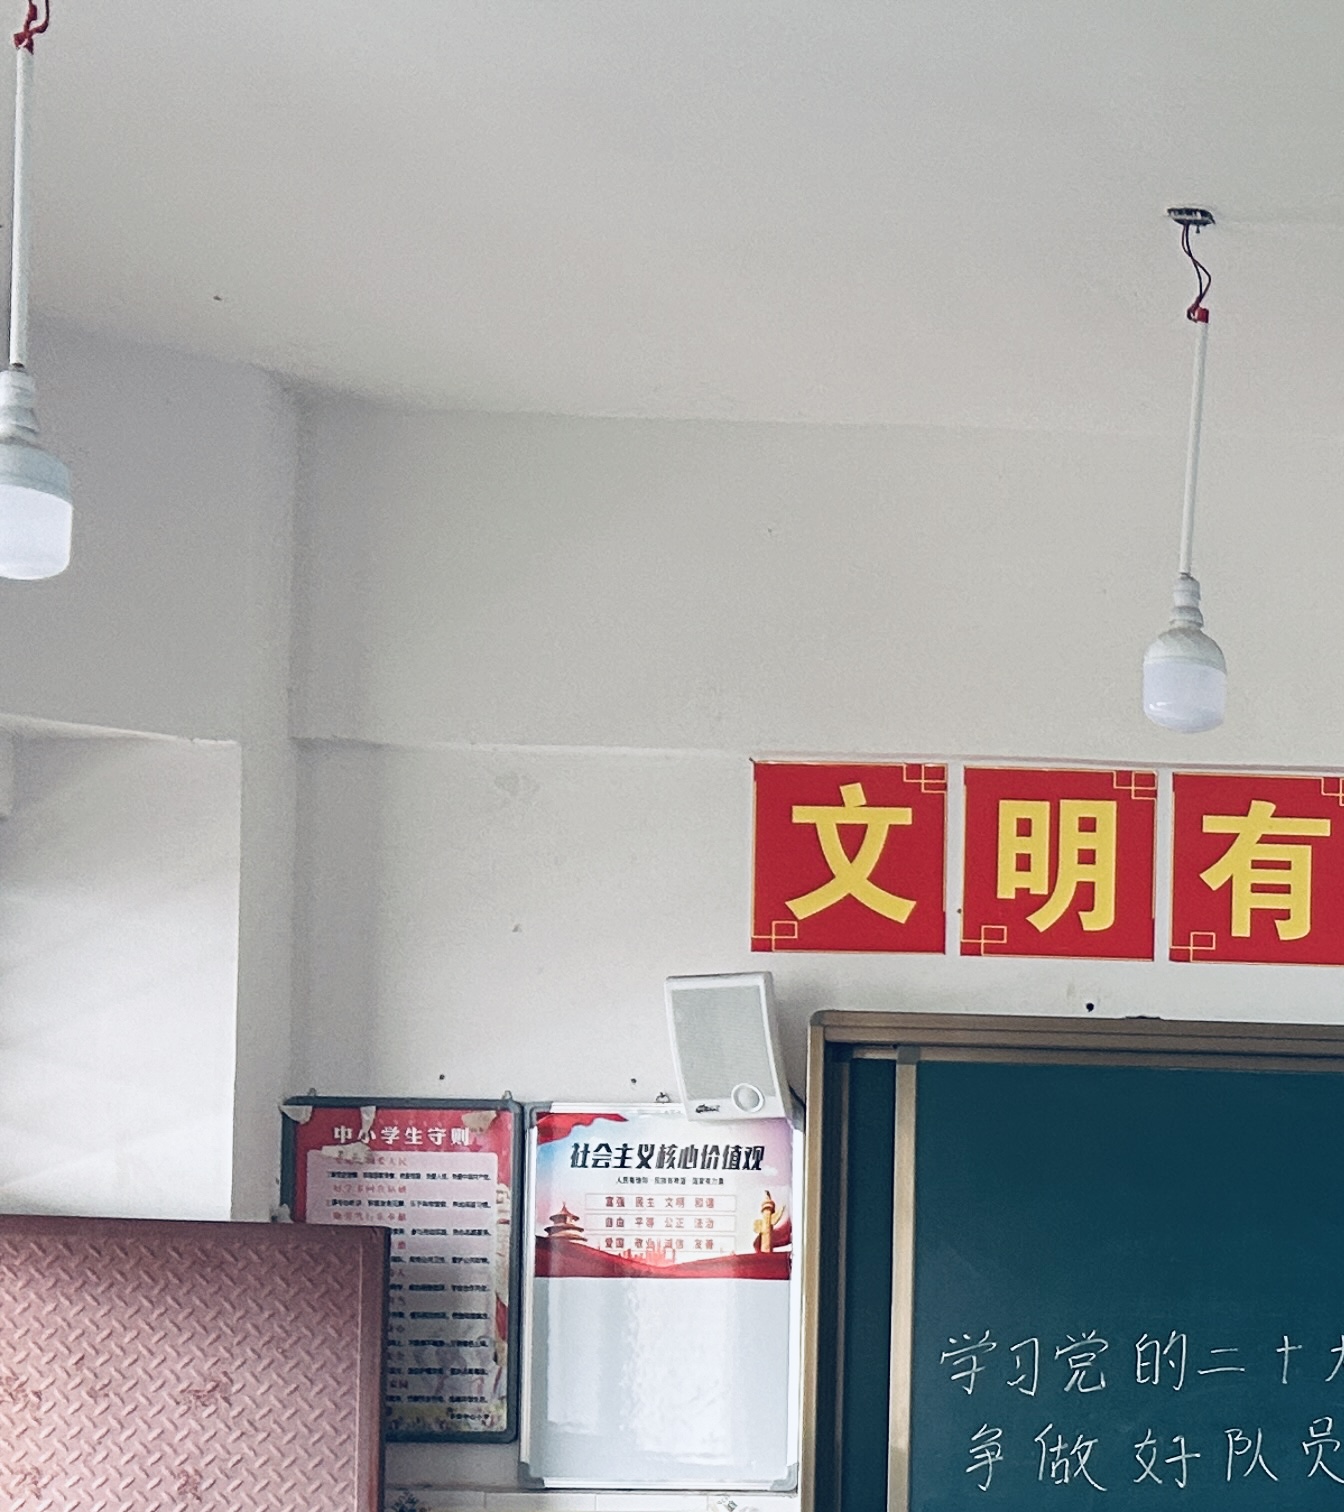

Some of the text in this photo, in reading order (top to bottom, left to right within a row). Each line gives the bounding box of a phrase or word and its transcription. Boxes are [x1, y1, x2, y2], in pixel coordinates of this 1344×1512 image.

[334, 1124, 470, 1146] 中小学生守则
[570, 1142, 765, 1171] 社会主义核心价值观
